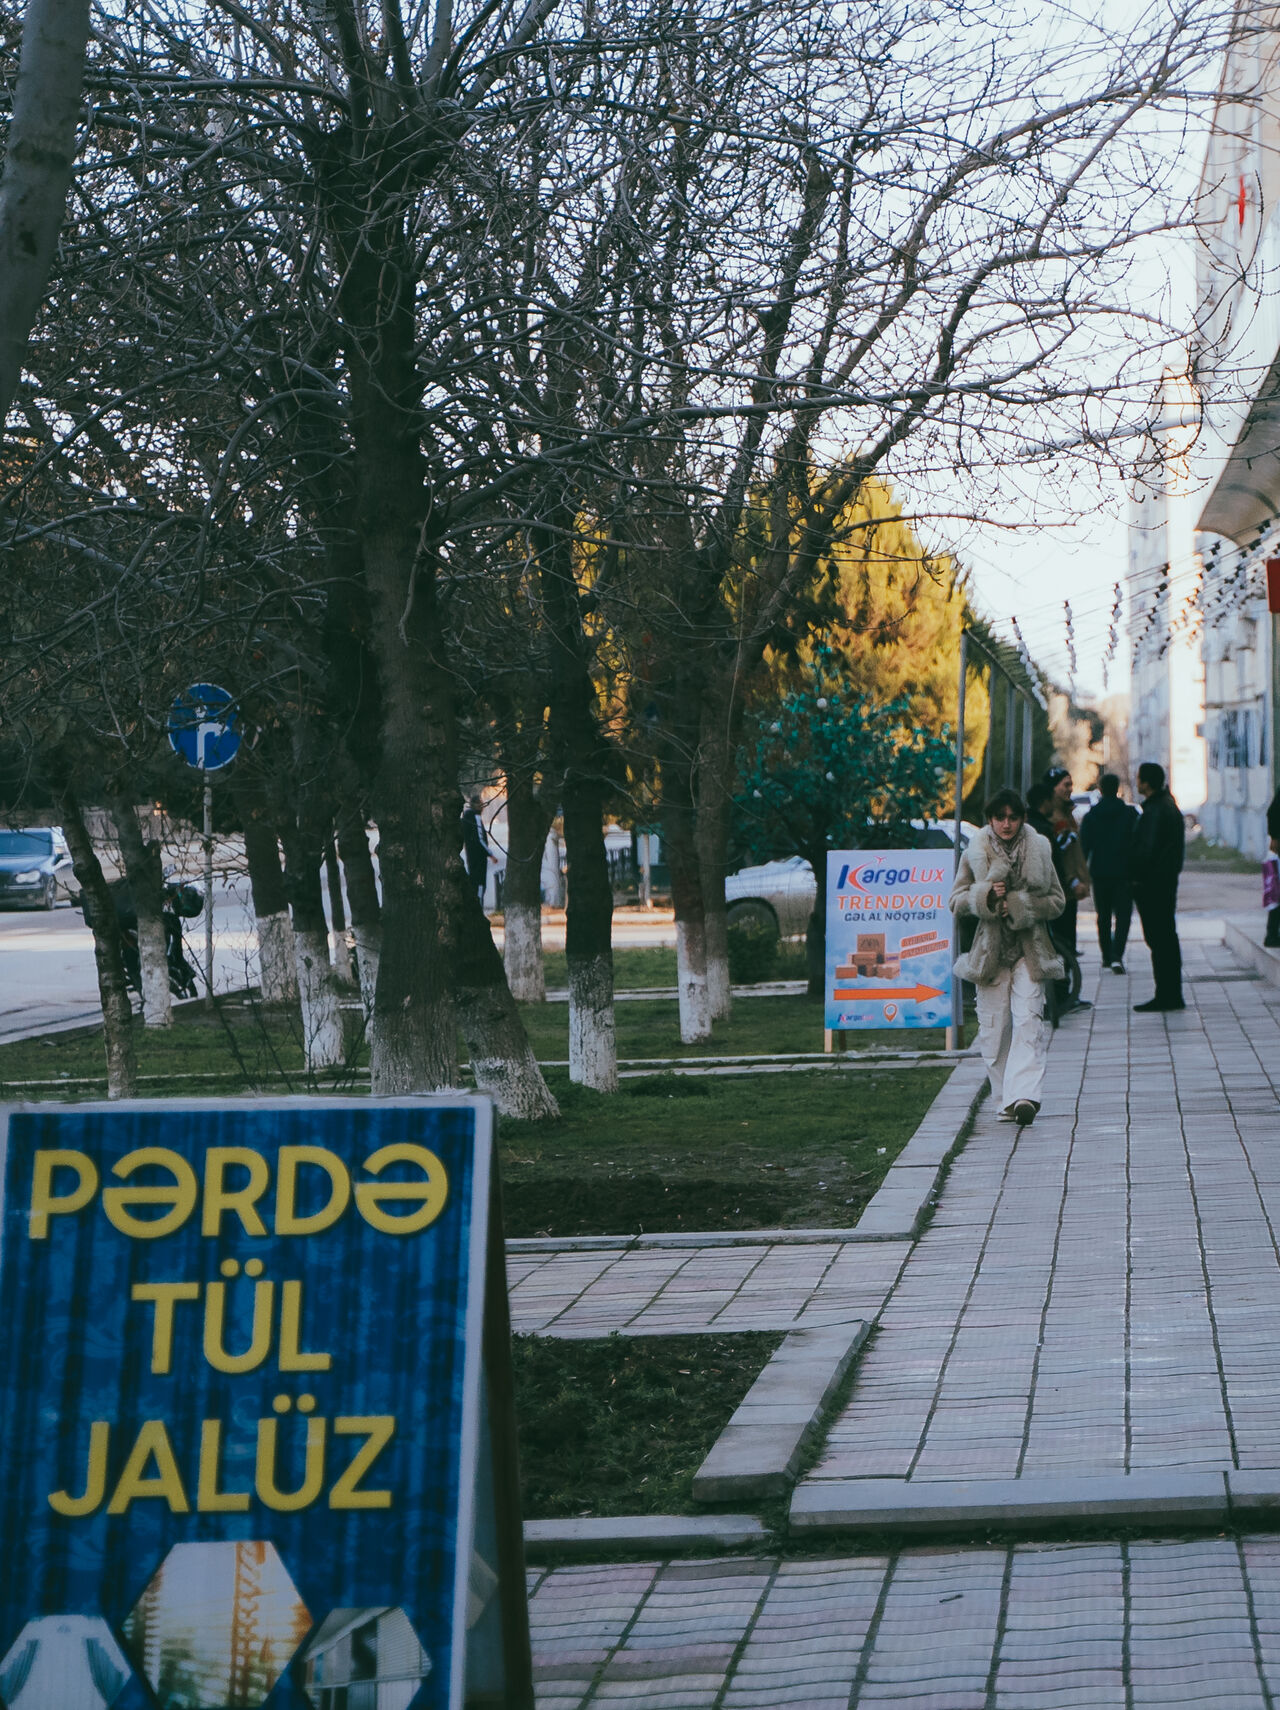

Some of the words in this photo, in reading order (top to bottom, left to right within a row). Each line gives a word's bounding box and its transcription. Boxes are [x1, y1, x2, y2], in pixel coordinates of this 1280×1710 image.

[837, 894, 945, 910] TRENDYOL
[844, 912, 866, 922] GƏL
[868, 912, 881, 921] AL
[884, 909, 937, 922] NÖQTƏSİ
[28, 1142, 450, 1240] PƏRDƏ
[131, 1257, 332, 1375] TÜL
[47, 1393, 396, 1517] JALÜZ
